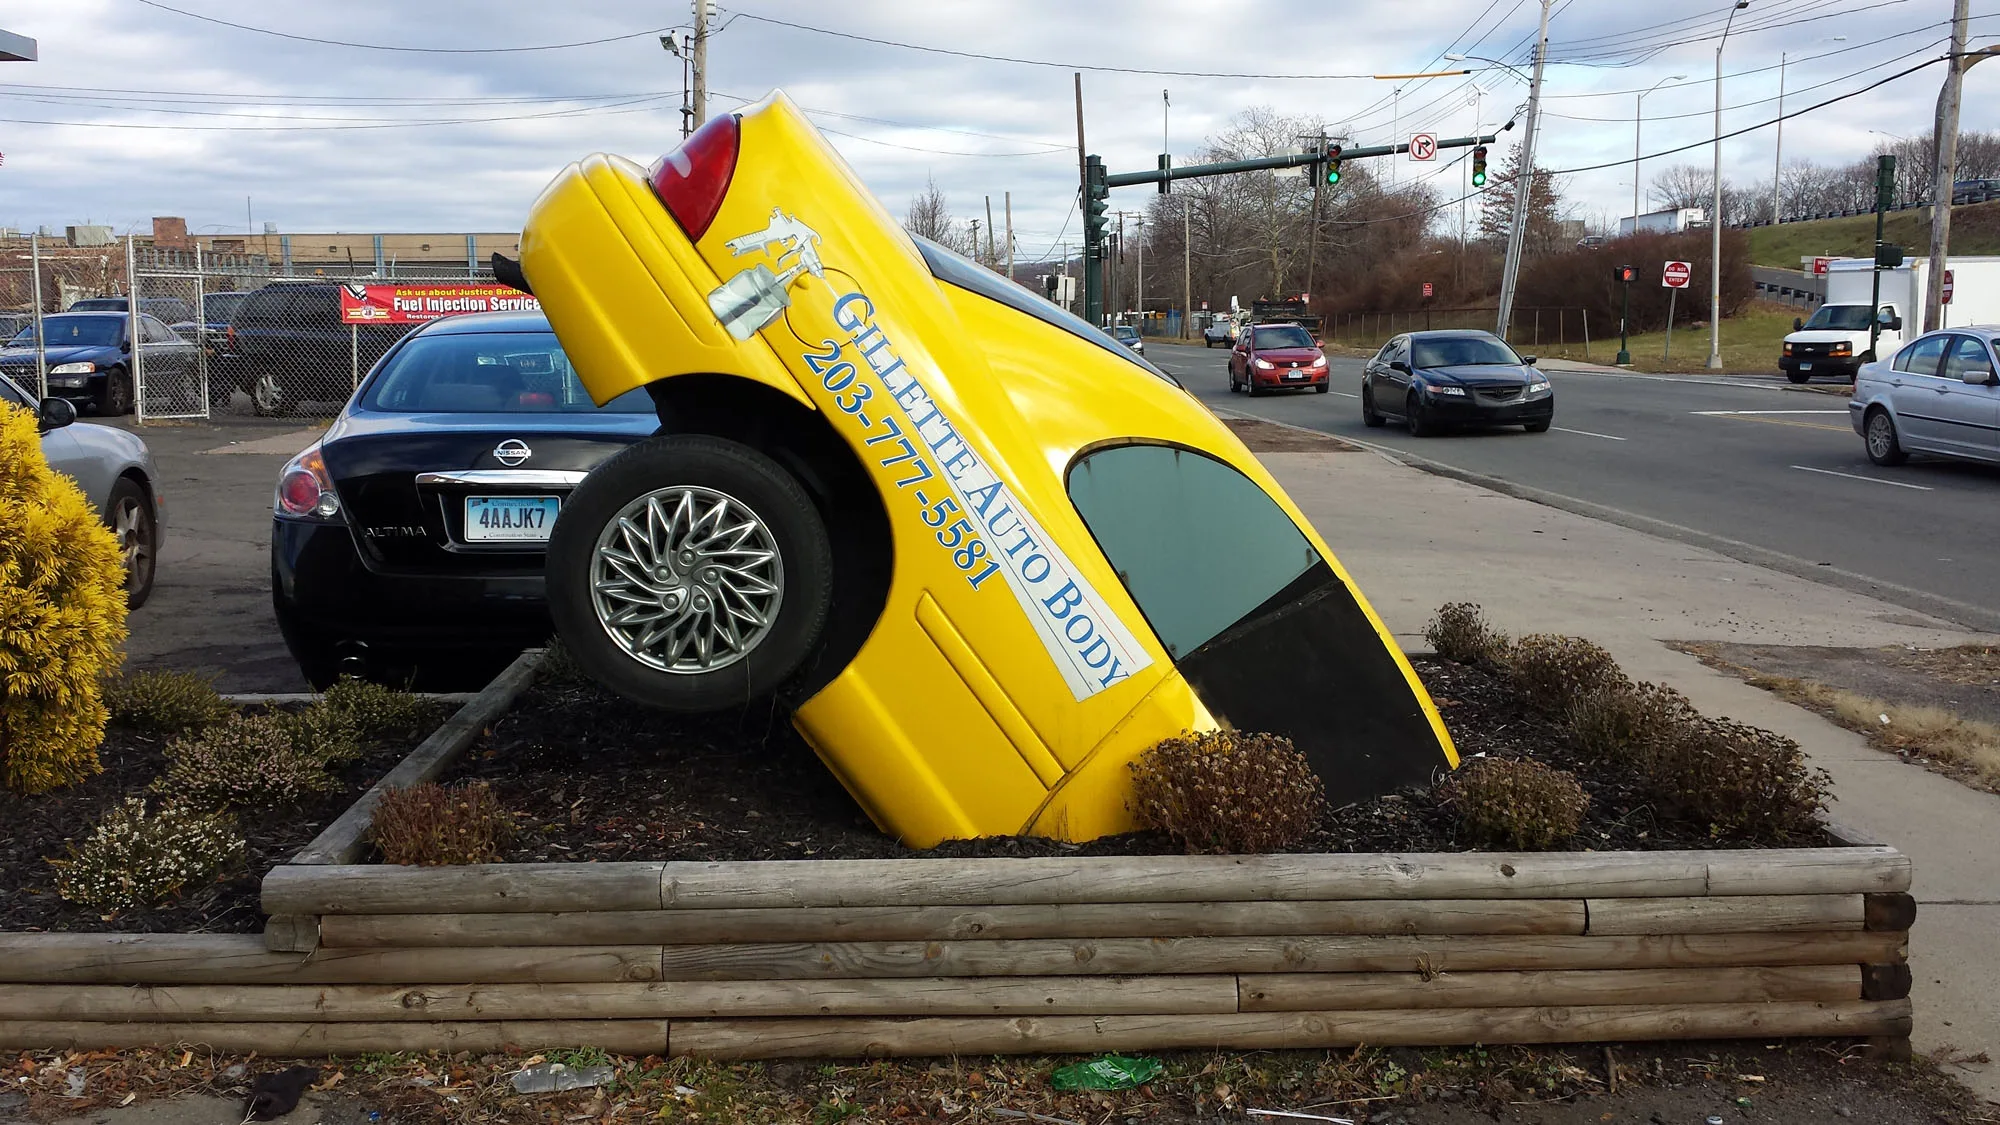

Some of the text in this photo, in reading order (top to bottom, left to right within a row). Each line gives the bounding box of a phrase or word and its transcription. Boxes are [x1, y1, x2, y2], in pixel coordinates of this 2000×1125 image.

[396, 288, 413, 296] Ask
[429, 288, 456, 296] about
[459, 288, 494, 296] Justice
[393, 297, 423, 312] Fuel
[426, 297, 487, 313] Injection
[496, 449, 527, 457] NISSAN
[802, 340, 1000, 590] 203-777-5581
[833, 293, 1130, 688] GILLETTE AUTO BODY
[479, 507, 546, 529] 4AAJK7
[364, 525, 427, 538] ALTIMA
